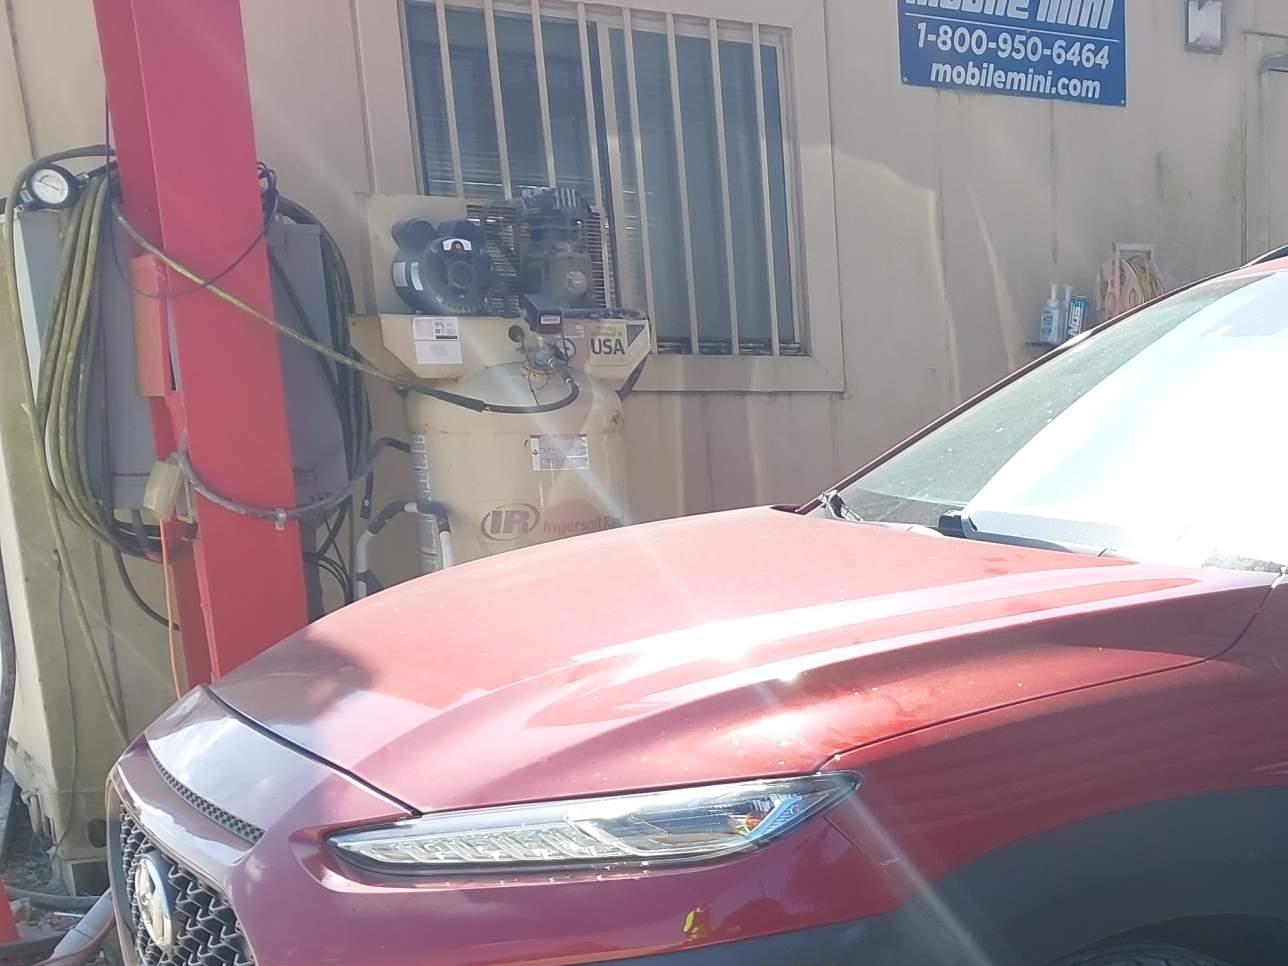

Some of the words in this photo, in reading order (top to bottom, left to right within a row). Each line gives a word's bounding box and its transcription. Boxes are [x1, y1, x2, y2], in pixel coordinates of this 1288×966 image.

[916, 22, 1110, 69] 1-800-950-6464
[930, 61, 1101, 98] mobilemini.com
[591, 338, 625, 355] USA
[490, 510, 529, 534] IR
